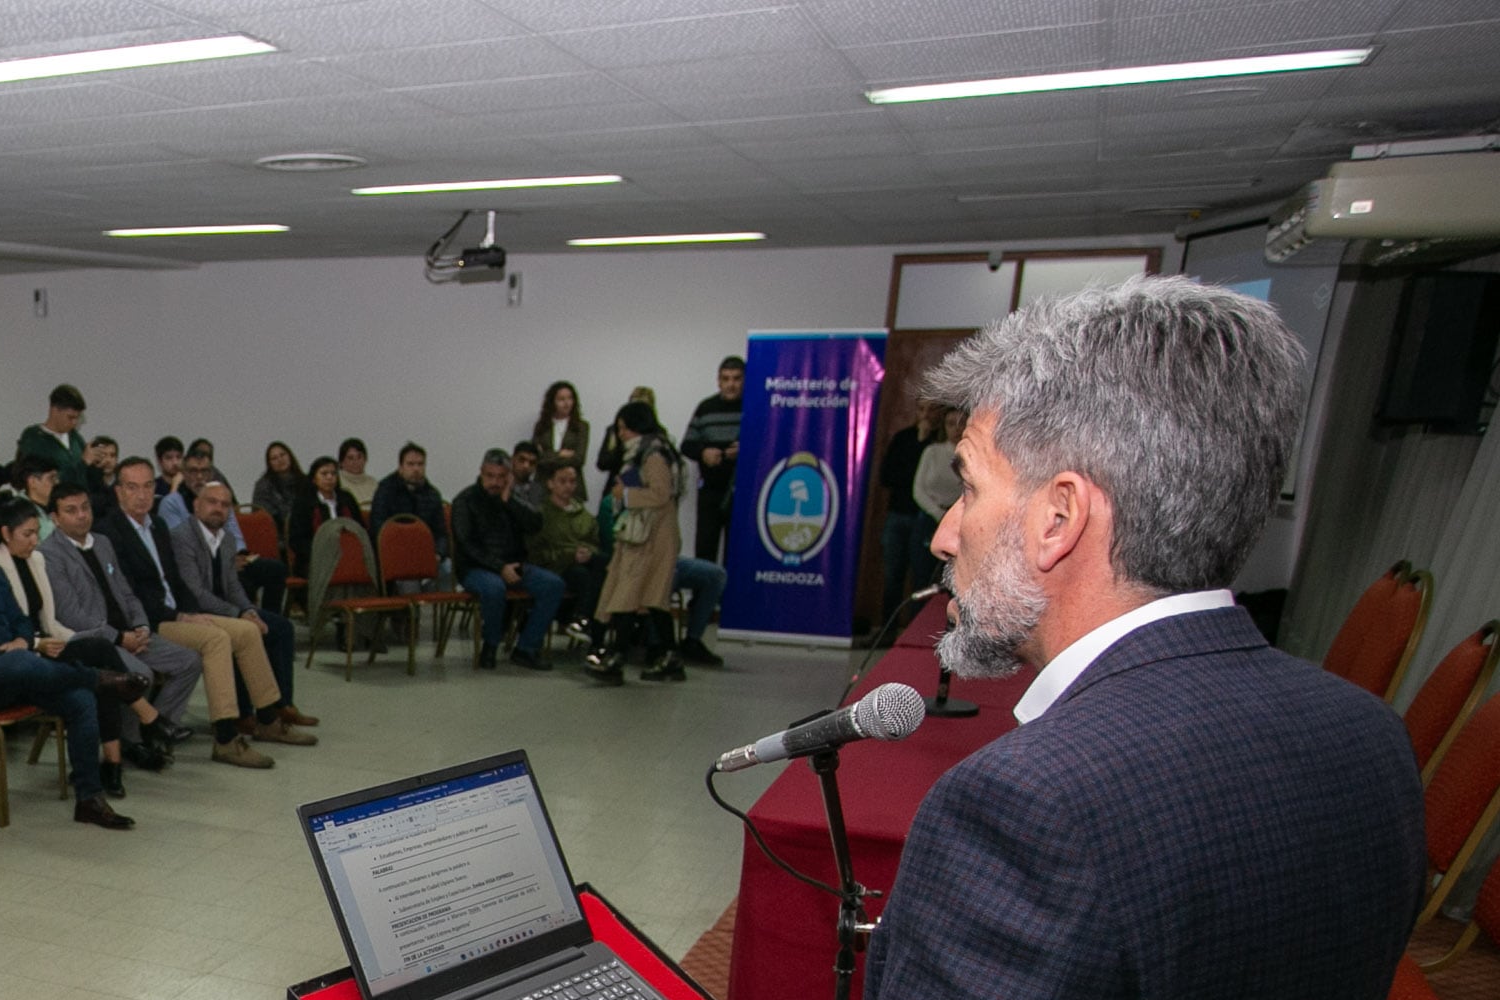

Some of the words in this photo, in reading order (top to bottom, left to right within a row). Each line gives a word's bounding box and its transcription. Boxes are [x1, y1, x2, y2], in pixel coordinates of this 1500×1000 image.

[766, 376, 836, 392] Ministerio
[840, 378, 856, 391] de
[771, 392, 848, 409] Producción
[755, 570, 824, 586] MENDOZA
